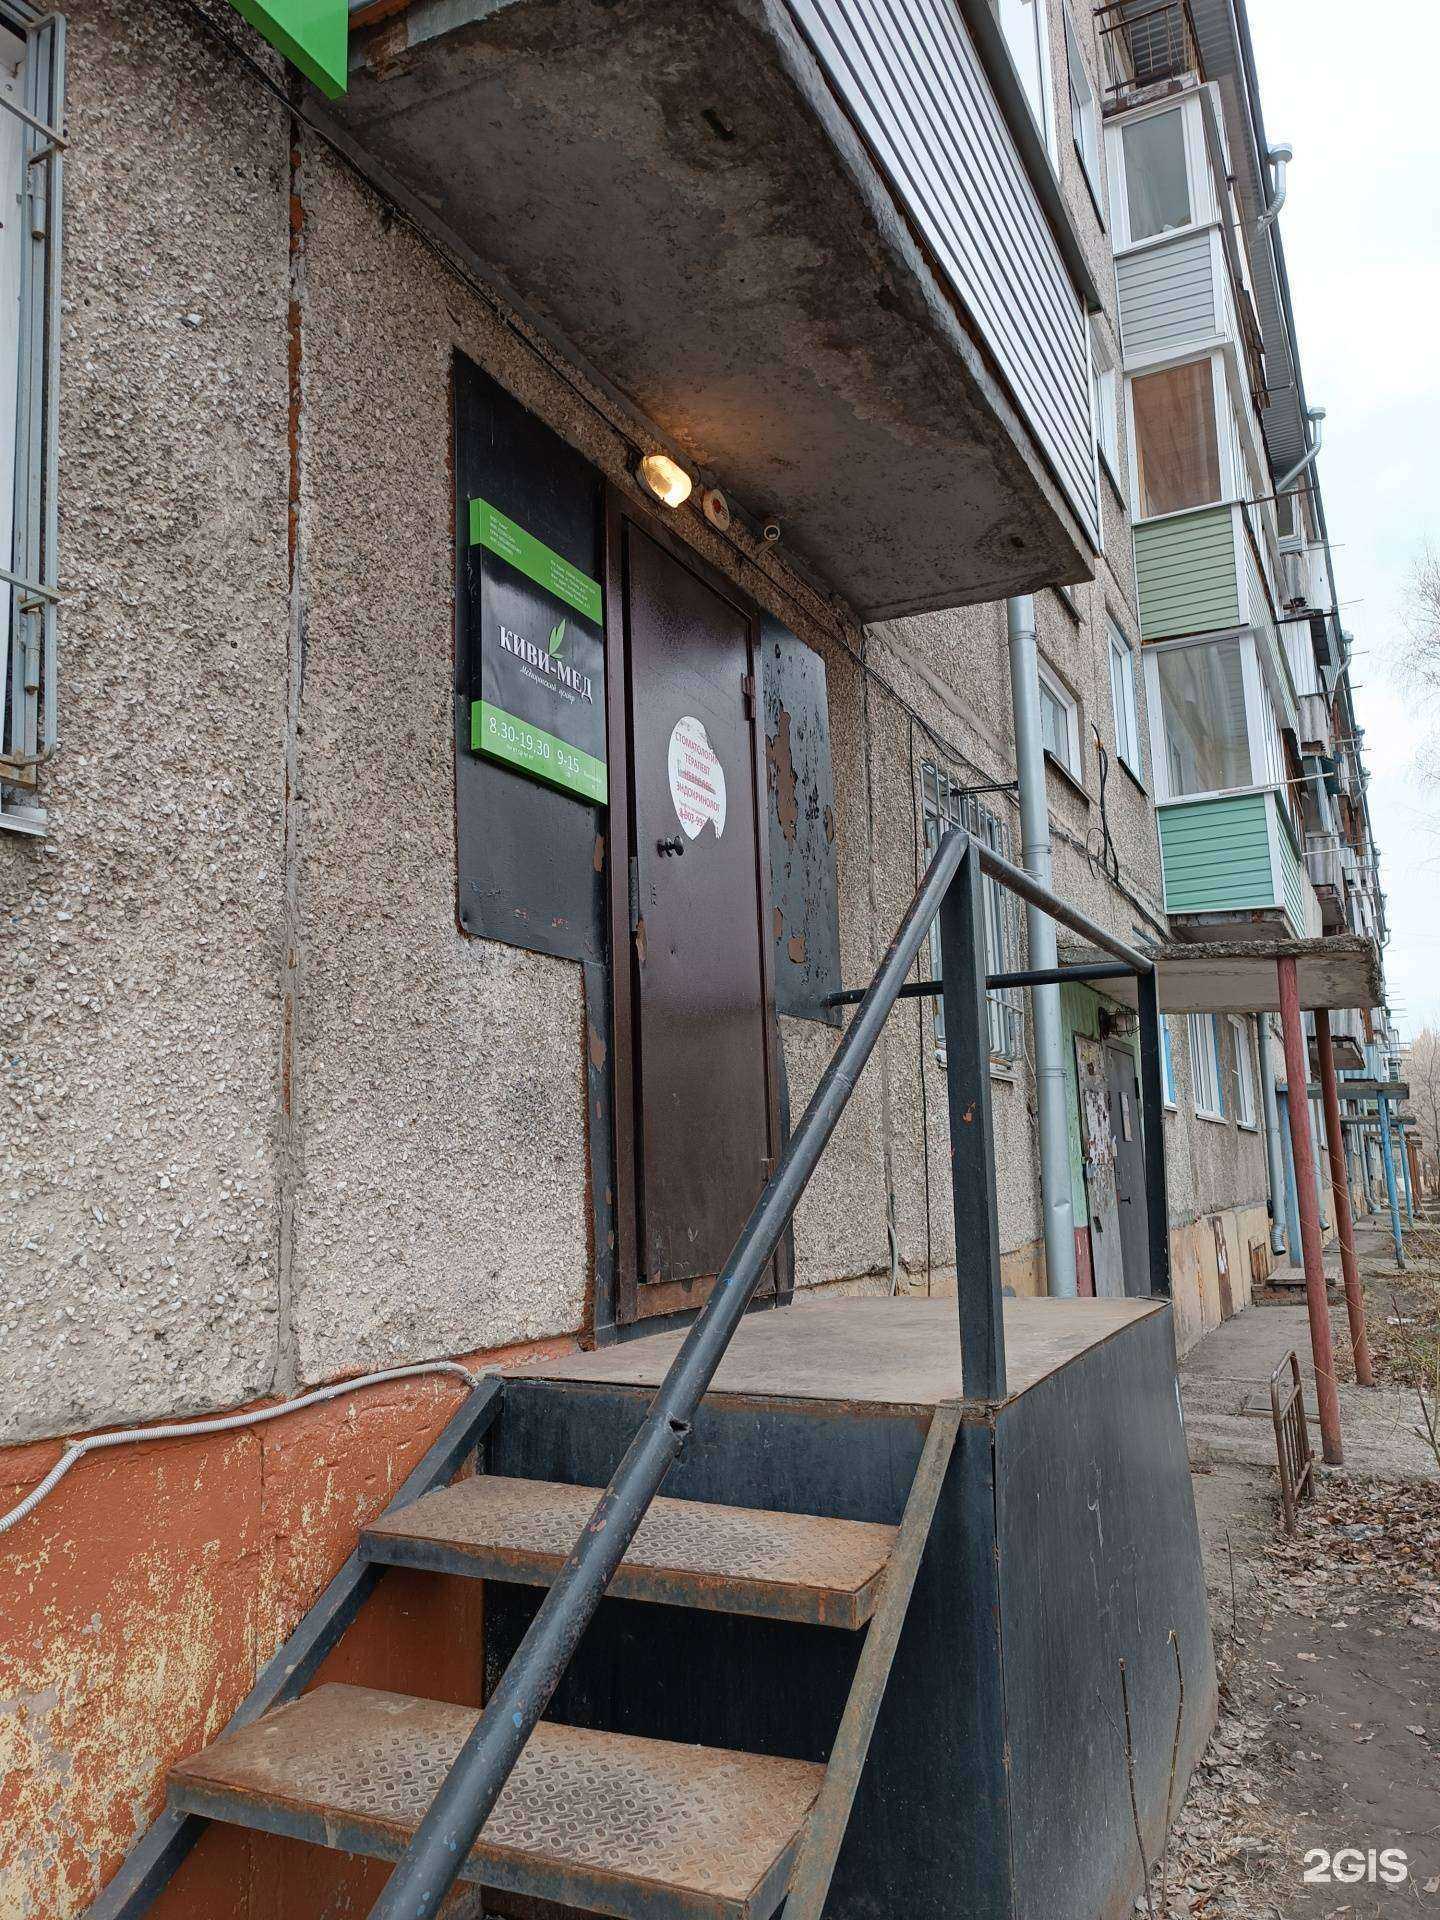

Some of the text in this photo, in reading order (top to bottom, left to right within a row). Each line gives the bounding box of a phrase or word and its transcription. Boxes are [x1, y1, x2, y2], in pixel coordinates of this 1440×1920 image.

[497, 624, 592, 704] КИВИ-МЕД
[489, 717, 550, 760] 8.30-19.30
[557, 750, 579, 773] 9-15
[684, 752, 710, 775] ТЕРАПЕВТ
[675, 780, 720, 812] ЭНДОКРИНОЛОГ
